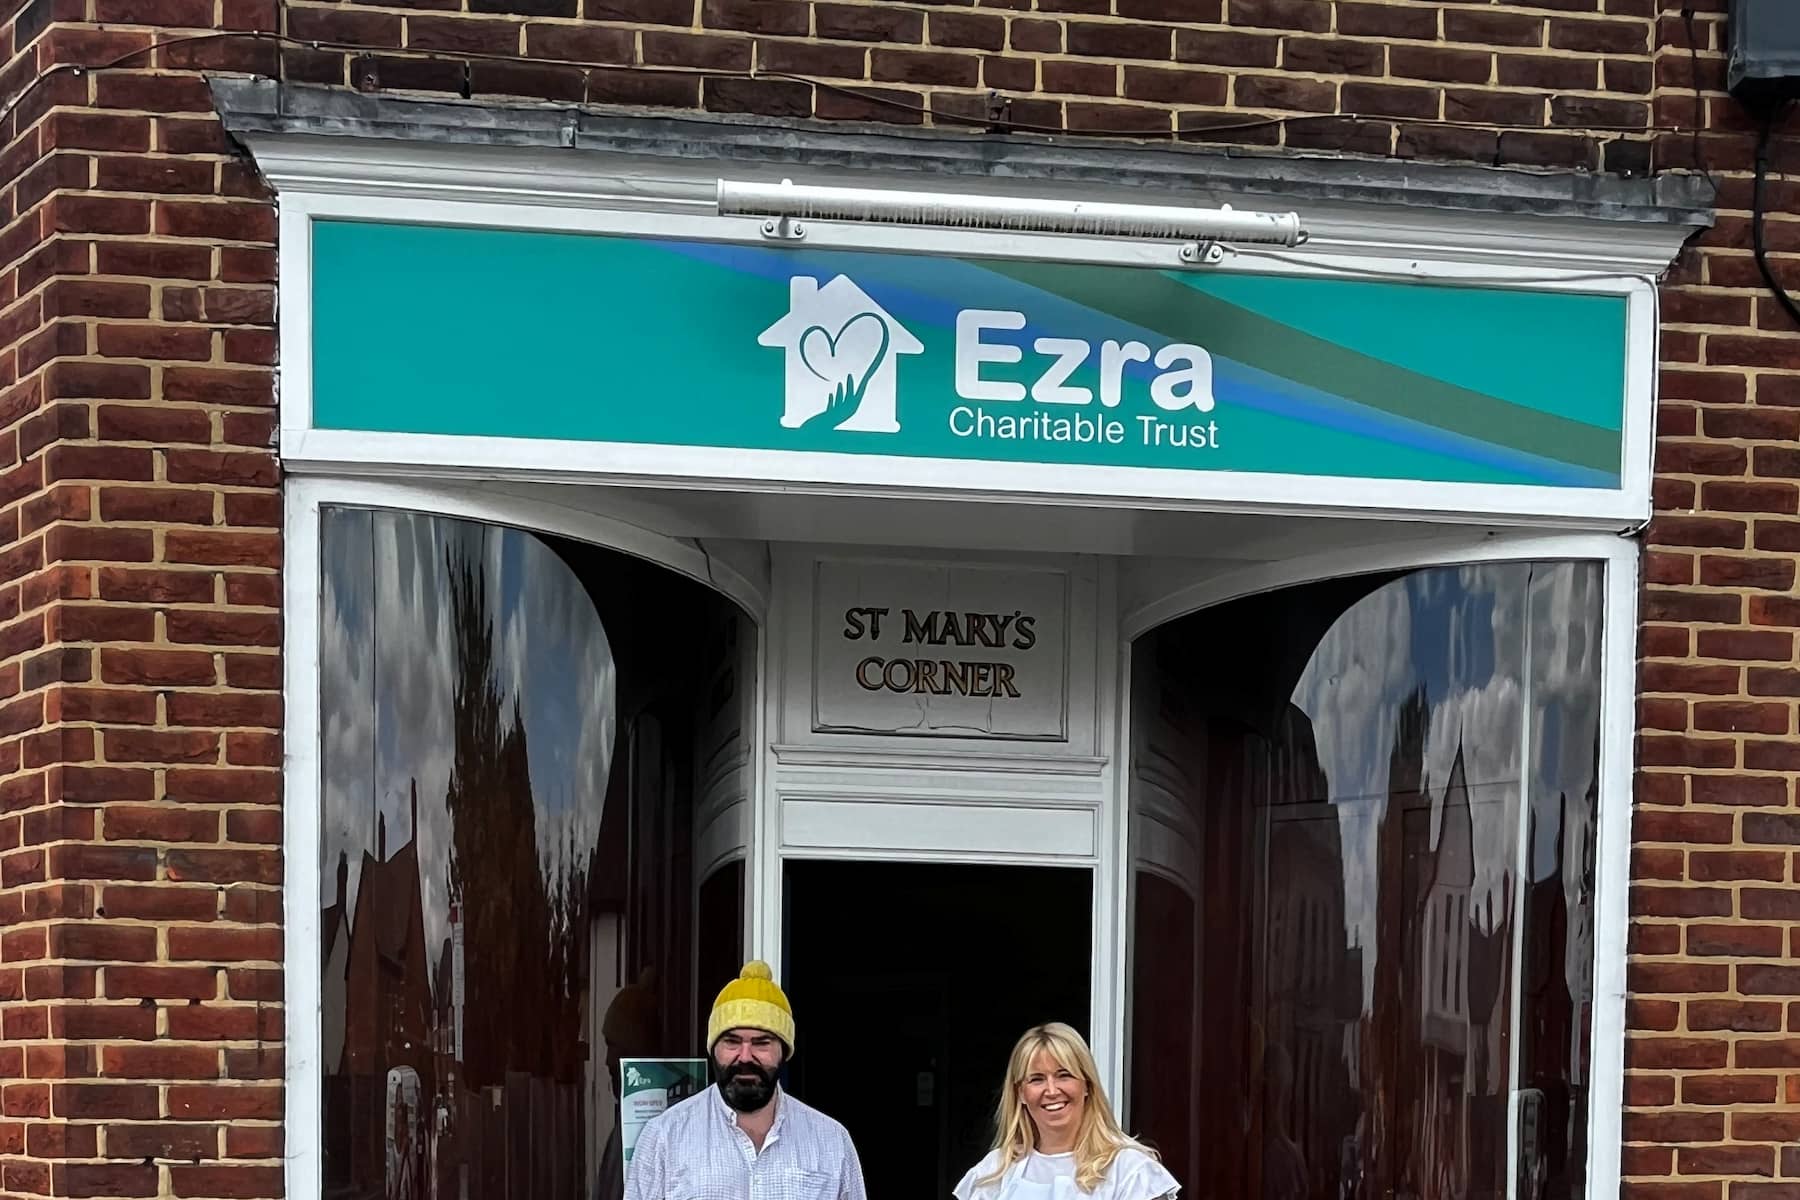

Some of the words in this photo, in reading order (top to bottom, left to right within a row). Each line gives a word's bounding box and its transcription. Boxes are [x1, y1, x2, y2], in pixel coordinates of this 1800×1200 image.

[955, 309, 1215, 412] Ezra
[948, 407, 1125, 443] Charitable
[1136, 416, 1220, 448] Trust
[843, 607, 888, 639] ST
[902, 609, 1036, 649] MARY'S
[856, 656, 1021, 697] CORNER
